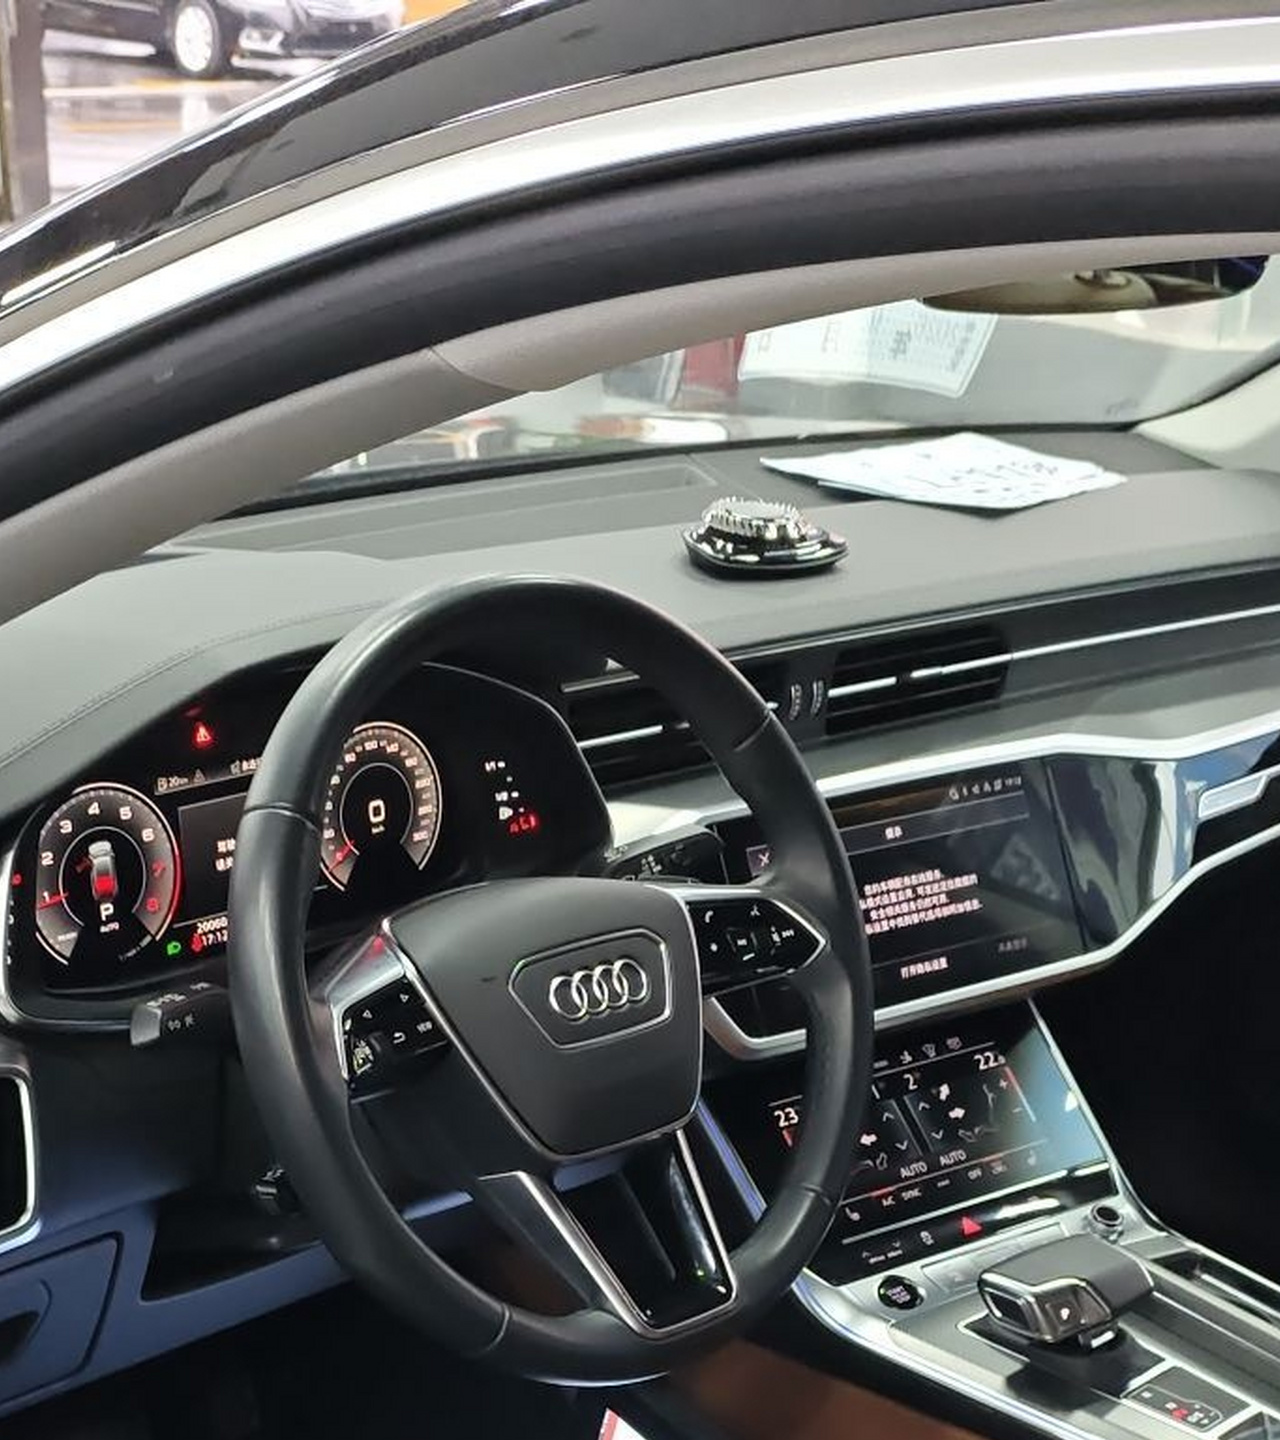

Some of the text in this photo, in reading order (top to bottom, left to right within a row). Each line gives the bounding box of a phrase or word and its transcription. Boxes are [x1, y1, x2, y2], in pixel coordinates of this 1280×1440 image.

[87, 801, 101, 816] 4
[119, 806, 133, 820] 5
[368, 798, 386, 823] 0
[59, 819, 73, 834] 3
[141, 828, 155, 842] 6
[41, 851, 54, 866] 2
[100, 903, 114, 921] P
[939, 1149, 967, 1167] AUTO
[899, 1161, 928, 1179] AUTO
